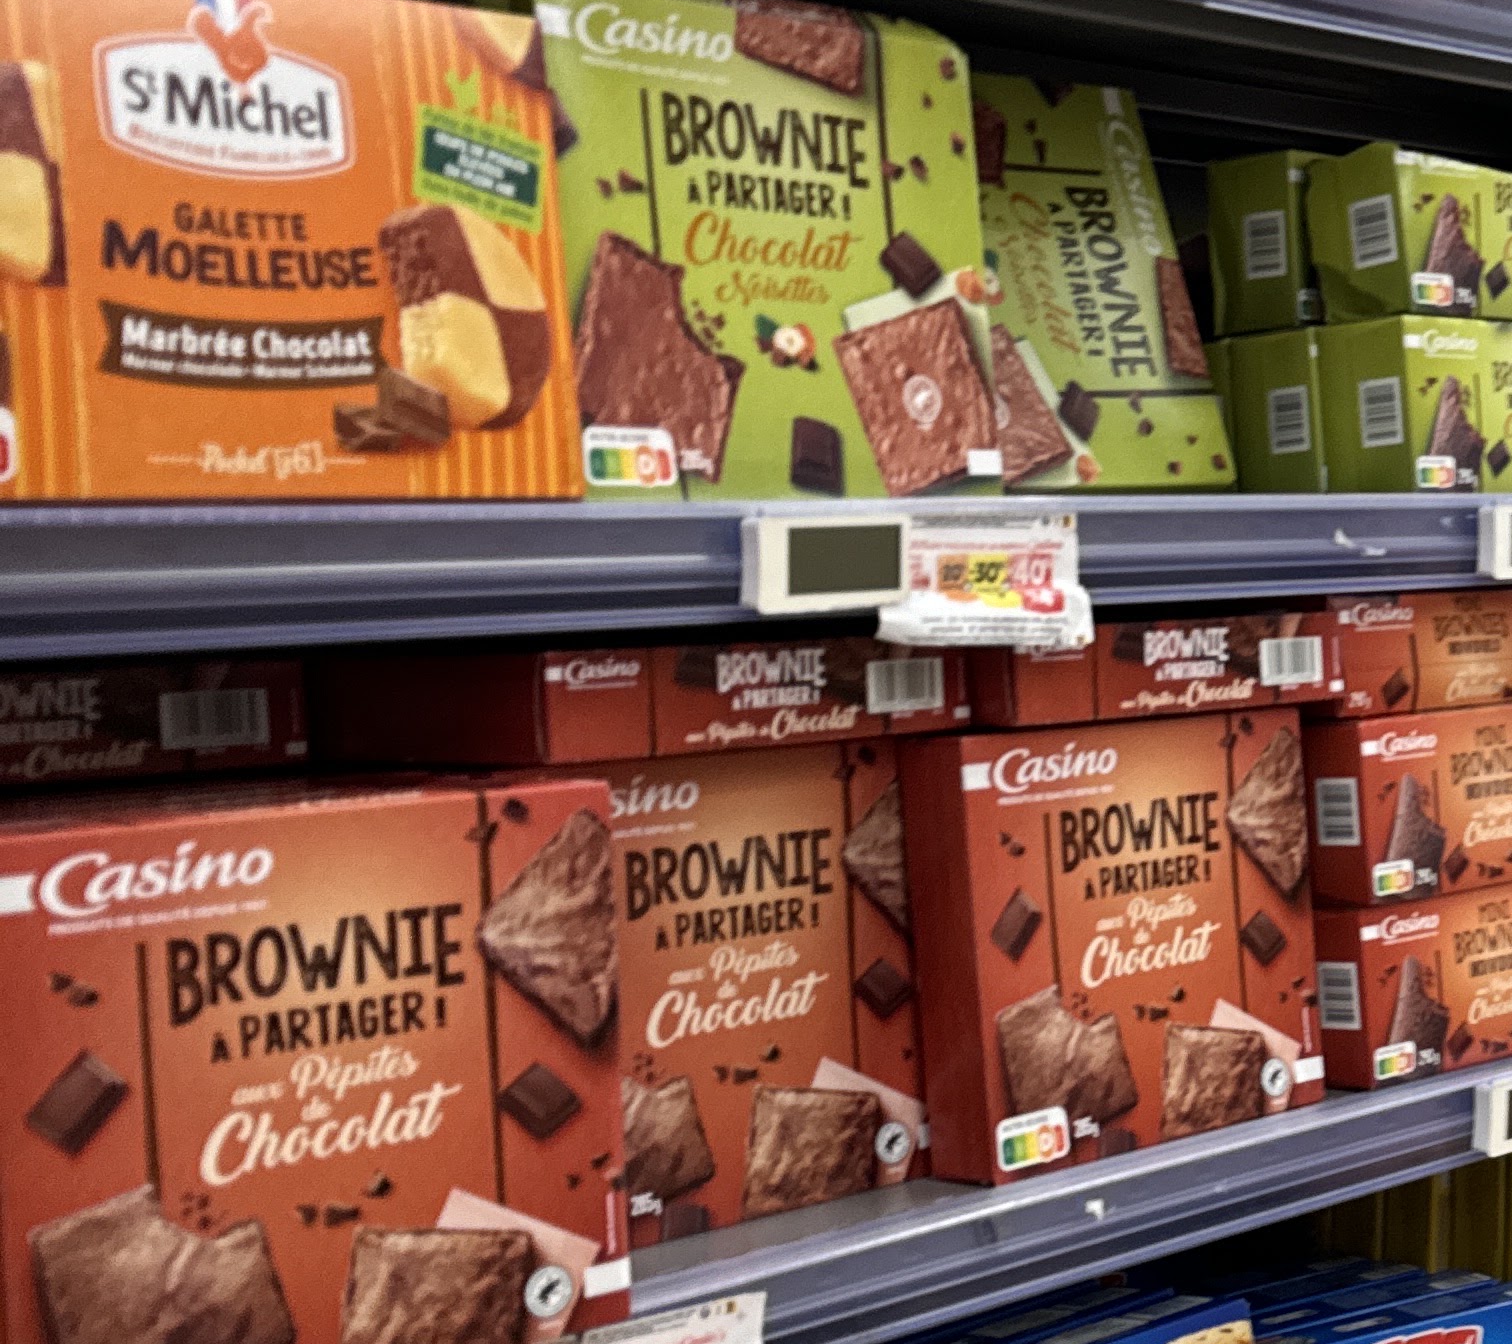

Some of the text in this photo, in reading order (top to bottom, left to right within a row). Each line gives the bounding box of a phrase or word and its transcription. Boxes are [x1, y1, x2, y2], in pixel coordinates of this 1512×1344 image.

[575, 2, 734, 63] Casino
[164, 72, 331, 141] Michel
[663, 90, 870, 188] BROWNIE
[174, 203, 308, 242] GALETTE
[706, 169, 837, 219] PARTAGER
[102, 217, 380, 291] MOELLEUSE
[684, 209, 864, 272] Chocolat
[1065, 185, 1159, 378] BROWNIE
[121, 315, 372, 358] Marbrée Chocolat
[716, 647, 829, 694] BROWNIE
[1143, 626, 1230, 667] BROWNIE
[769, 705, 864, 740] Chocolat
[608, 774, 700, 813] sino
[993, 742, 1119, 794] Casino
[1060, 791, 1221, 873] BROWNIE
[40, 841, 275, 918] Casino
[626, 828, 833, 922] BROWNIE
[1099, 855, 1199, 897] PARTAGER
[674, 901, 805, 947] PARTAGER
[1080, 919, 1222, 989] Chocolat
[166, 903, 466, 1027] BROWNIE
[238, 992, 425, 1058] PARTAGER
[646, 971, 830, 1049] Chocolat
[290, 1046, 419, 1103] Pépites
[199, 1081, 464, 1187] Chocolat
